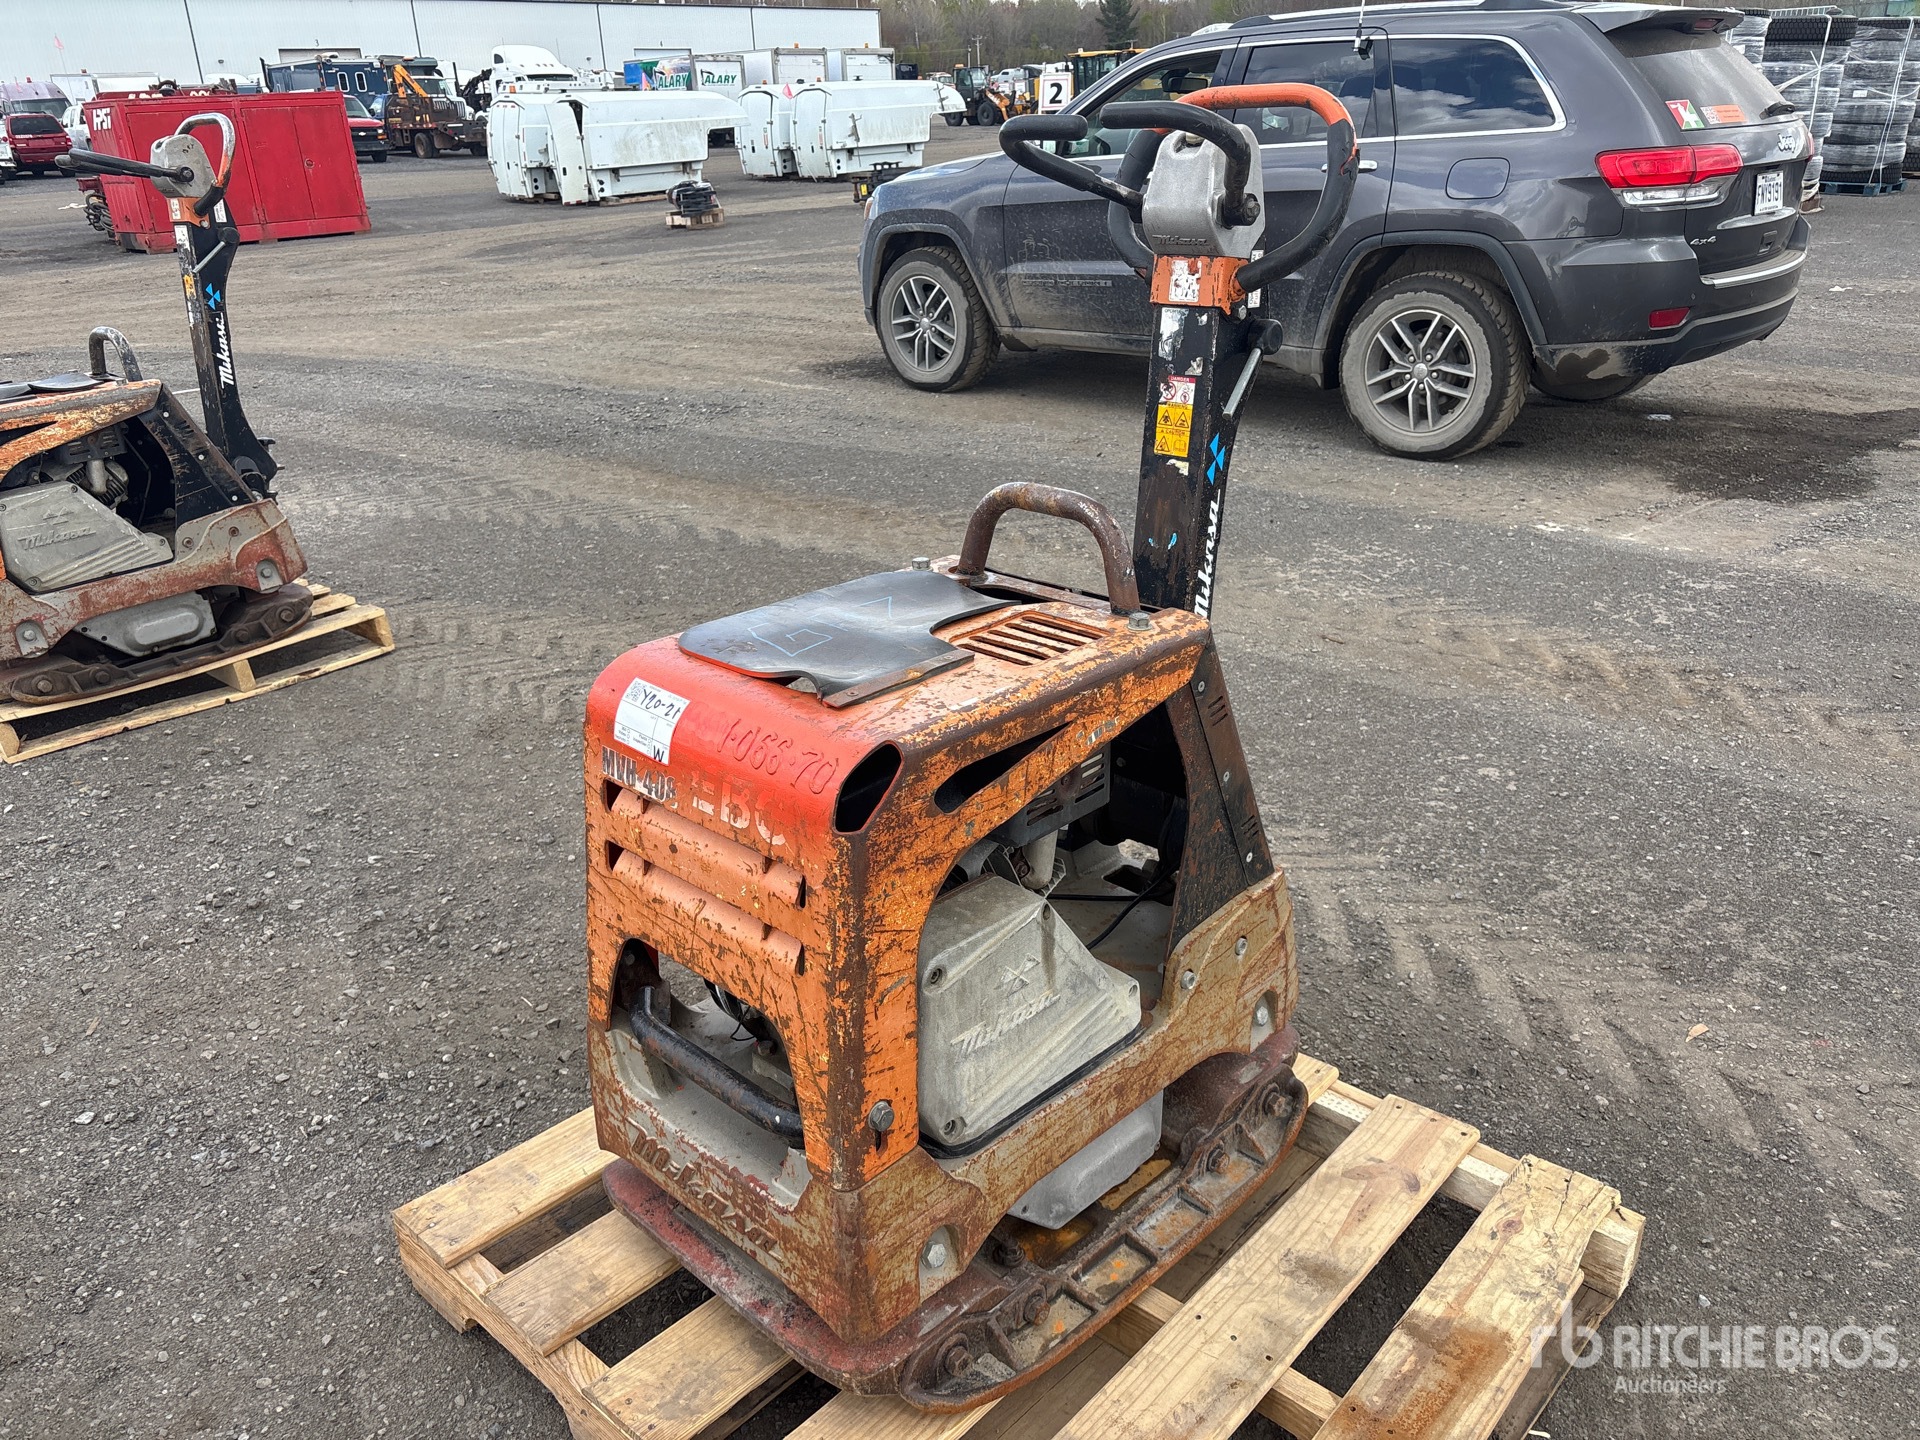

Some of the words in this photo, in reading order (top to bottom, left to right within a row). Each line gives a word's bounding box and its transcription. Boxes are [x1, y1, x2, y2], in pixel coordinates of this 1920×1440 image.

[658, 73, 688, 88] ALARY
[704, 74, 737, 84] ALARY
[1049, 82, 1063, 104] 2
[1777, 133, 1796, 153] Jeep
[216, 312, 234, 389] Mikasa
[17, 527, 97, 551] Mikasa
[654, 745, 665, 762] W
